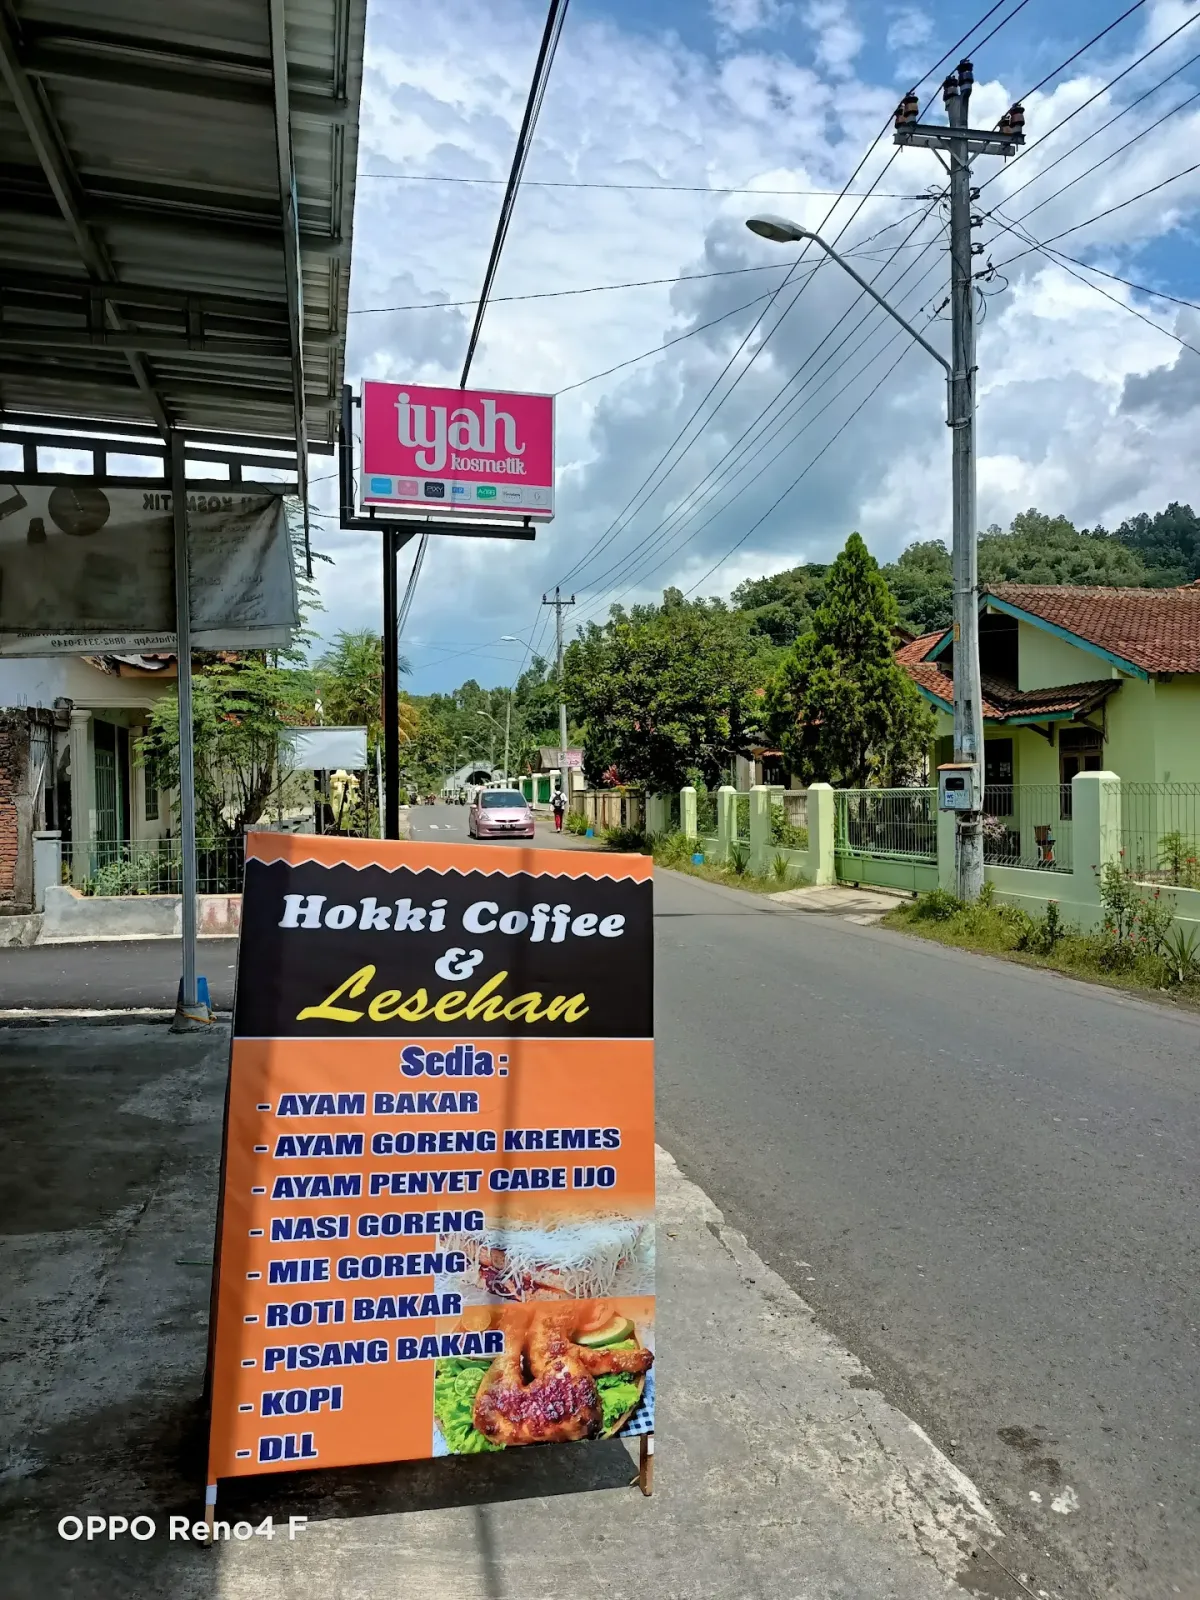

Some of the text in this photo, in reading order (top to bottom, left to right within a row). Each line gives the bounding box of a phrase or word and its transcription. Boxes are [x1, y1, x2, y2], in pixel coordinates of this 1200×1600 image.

[394, 392, 525, 472] iyah
[451, 453, 526, 475] kosmetik
[426, 485, 444, 493] PIXY
[278, 894, 626, 943] Hokki Coffee
[435, 947, 484, 980] &
[297, 965, 589, 1023] Lesehan
[276, 1093, 367, 1116] AYAM
[374, 1091, 479, 1115] BAKAR
[274, 1133, 365, 1157] AYAM
[372, 1130, 496, 1155] GORENG
[504, 1128, 621, 1152] KREMES
[272, 1174, 361, 1199] AYAM
[370, 1170, 482, 1195] PENYET
[489, 1167, 566, 1191] CABE
[574, 1166, 616, 1188] IJO
[271, 1215, 349, 1241] NASI
[358, 1210, 484, 1236] GORENG
[268, 1258, 329, 1285] MIE
[337, 1252, 468, 1281] GORENG
[265, 1299, 345, 1328] ROTI
[353, 1294, 462, 1320] BAKAR
[264, 1338, 389, 1371] PISANG
[397, 1331, 505, 1360] BAKAR
[261, 1386, 343, 1416] KOPI
[259, 1434, 318, 1462] DLL
